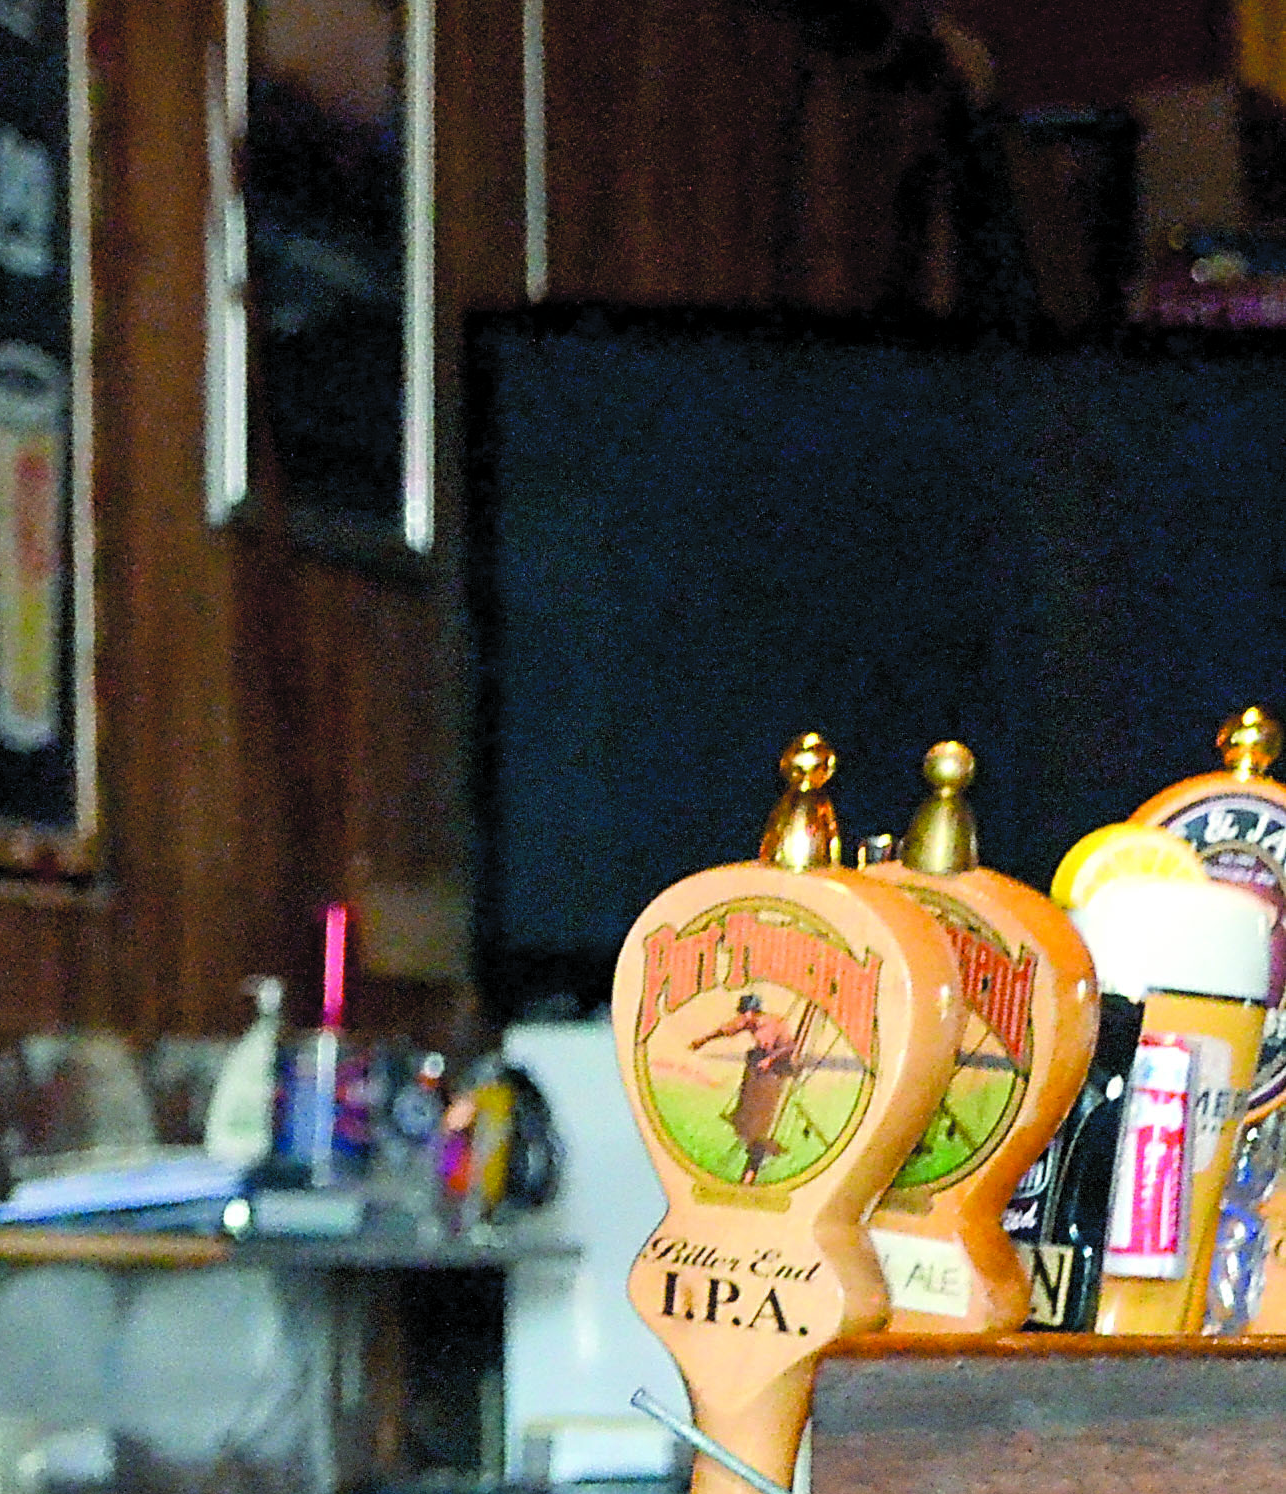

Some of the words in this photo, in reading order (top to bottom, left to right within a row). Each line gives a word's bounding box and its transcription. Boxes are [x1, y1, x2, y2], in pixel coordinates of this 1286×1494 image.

[749, 1247, 822, 1282] End
[904, 1262, 960, 1297] ALE
[662, 1271, 809, 1337] I.P.A.
